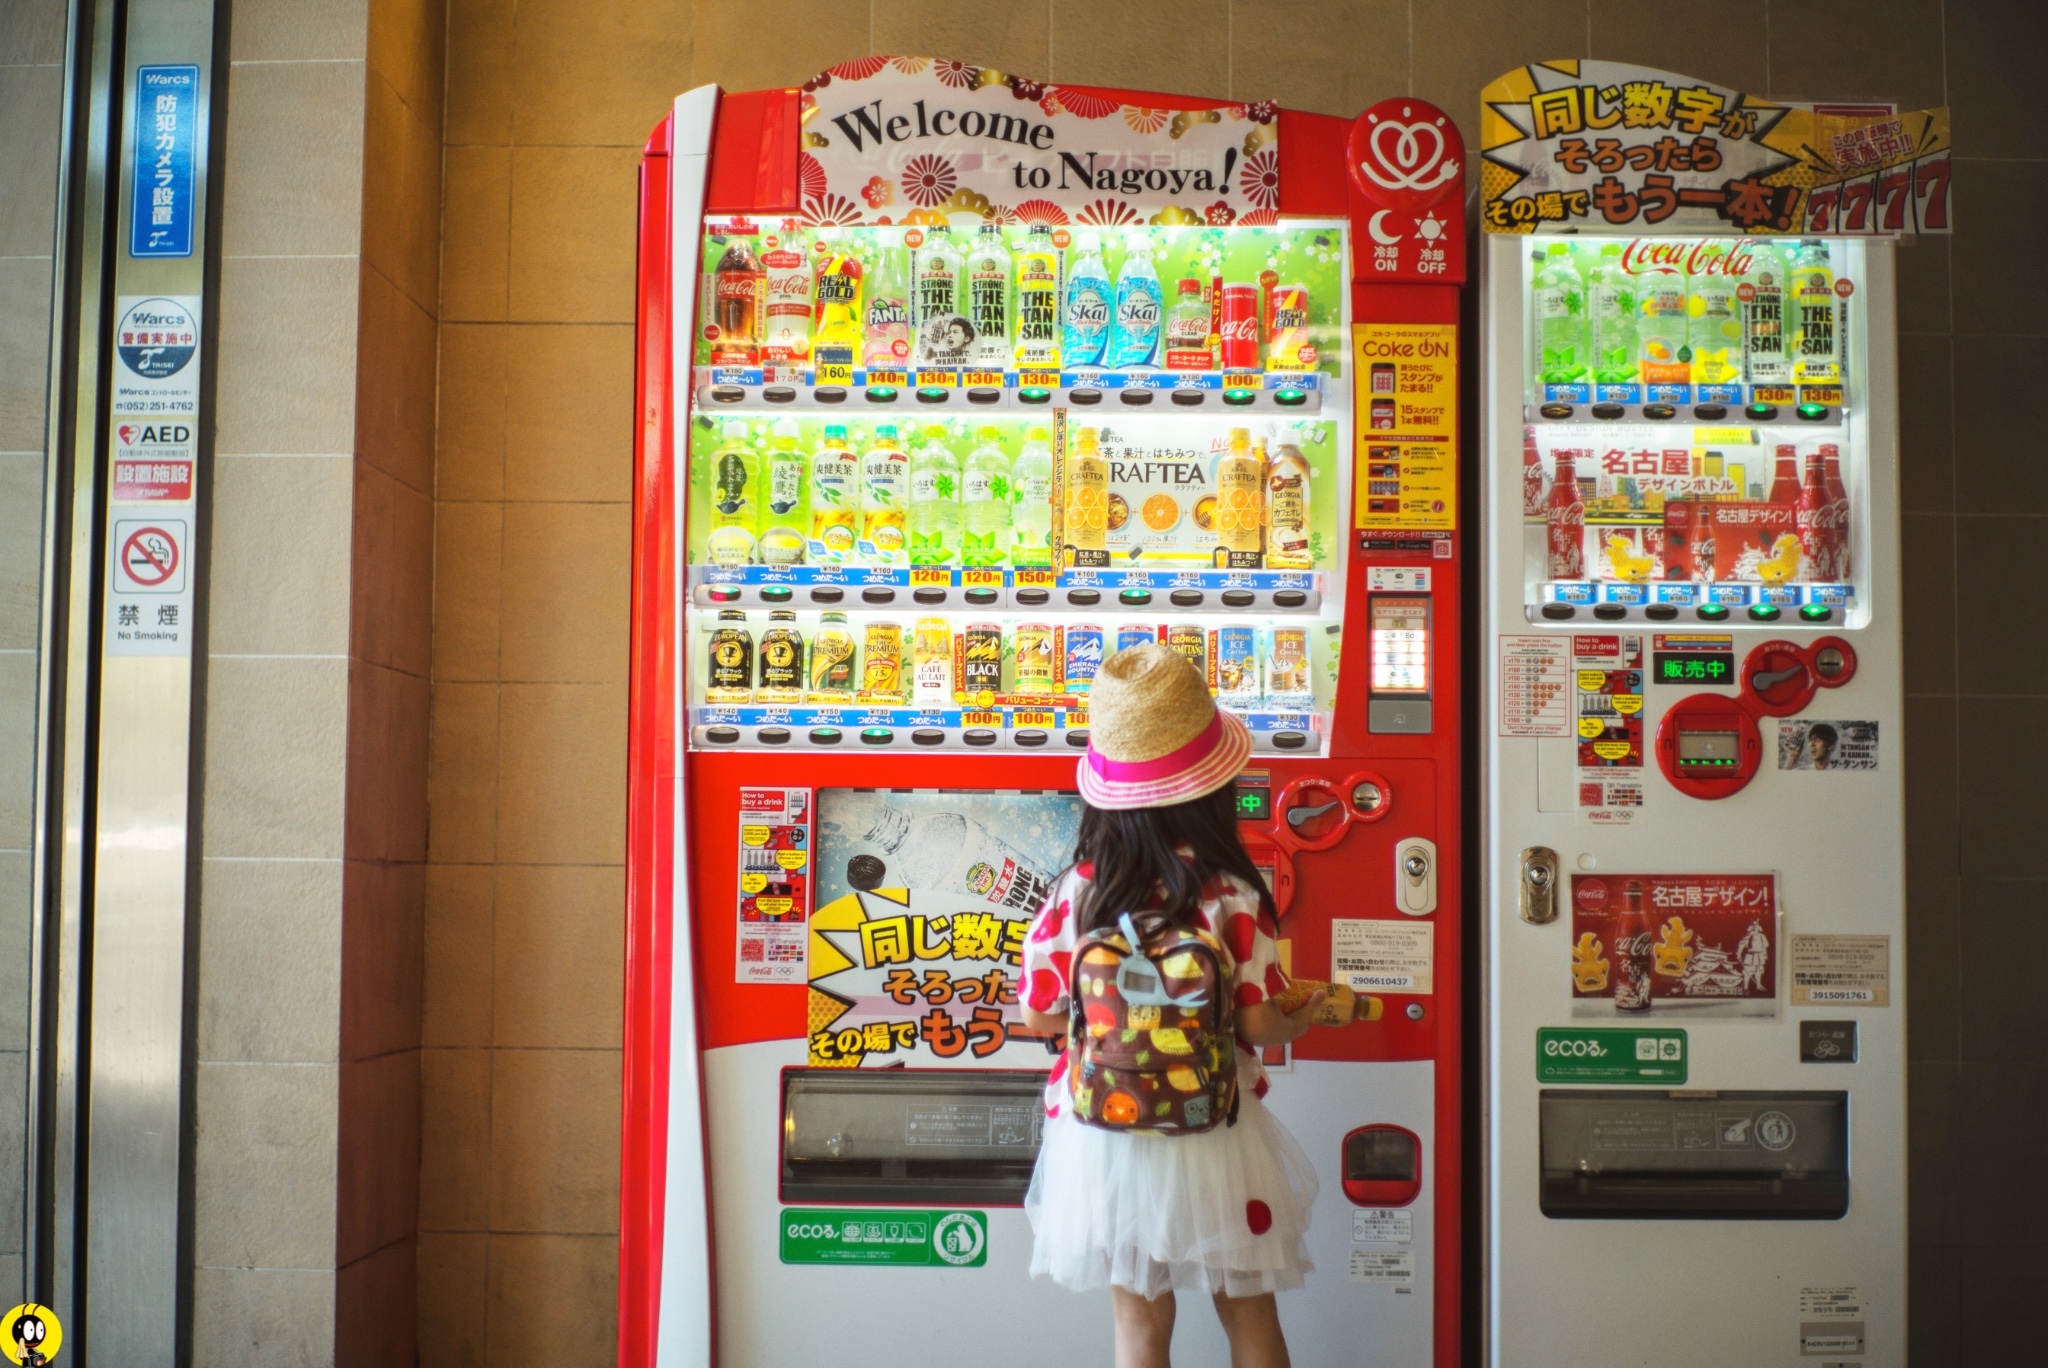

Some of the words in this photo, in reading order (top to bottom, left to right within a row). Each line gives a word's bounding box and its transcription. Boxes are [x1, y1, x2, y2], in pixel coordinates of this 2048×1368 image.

[146, 74, 190, 84] Warcs
[1529, 80, 1758, 141] 同じ数字が
[831, 99, 1055, 153] Welcome
[152, 95, 176, 224] 防犯カメラ設置
[1555, 138, 1723, 172] そろったら
[1014, 161, 1051, 190] to
[1059, 146, 1238, 194] Nagoya!
[1485, 190, 1588, 227] その場で
[1374, 246, 1398, 258] 冷却
[1420, 249, 1444, 261] 冷却
[1622, 238, 1753, 276] Coca-Cola
[1375, 260, 1397, 271] ON
[1418, 262, 1446, 274] OFF
[819, 275, 852, 286] REAL
[921, 280, 953, 289] STRONG
[973, 281, 1004, 290] STRONG
[818, 287, 854, 298] GOLD
[1837, 283, 1852, 292] NEW
[921, 290, 953, 304] THE
[973, 290, 1004, 305] THE
[1022, 292, 1053, 307] THE
[132, 313, 185, 324] Warcs
[869, 307, 906, 326] FANTA
[973, 306, 1004, 320] TAN
[1022, 308, 1053, 323] TAN
[1276, 308, 1303, 318] REAL
[1751, 306, 1781, 320] THE
[1801, 306, 1832, 321] THE
[1169, 318, 1208, 332] Coca-Cola
[1276, 318, 1304, 328] GOLD
[1022, 324, 1053, 340] SAN
[1801, 323, 1832, 338] TAN
[123, 332, 192, 344] 警備実施中
[1751, 336, 1782, 352] SAN
[1363, 341, 1414, 357] Coke
[1418, 339, 1448, 357] ON
[1801, 339, 1833, 354] SAN
[869, 373, 904, 382] 140円
[919, 373, 954, 384] 130円
[965, 373, 1001, 384] 130円
[1022, 374, 1057, 384] 130円
[1400, 373, 1443, 382] スタンプが
[1756, 390, 1792, 400] 130円
[1803, 390, 1840, 401] 130円
[1401, 405, 1444, 414] 15スタンプで
[141, 426, 190, 442] AED
[1602, 448, 1690, 475] 名古屋
[116, 464, 188, 484] 設置施設
[817, 463, 852, 475] 爽健美茶
[867, 463, 902, 475] 爽健美茶
[1638, 478, 1734, 492] デザインボトル
[1716, 509, 1792, 524] 名古屋デザイン!
[913, 571, 948, 582] 120円
[965, 572, 1000, 582] 120円
[118, 631, 131, 640] No
[134, 631, 178, 641] Smoking
[1172, 636, 1202, 644] GEORGIA
[813, 647, 849, 655] PREMIUM
[967, 665, 998, 676] BLACK
[1664, 660, 1725, 678] 販売中
[1005, 697, 1064, 705] バリューコーナー
[964, 713, 1000, 724] 100円
[1016, 713, 1052, 723] 100円
[1830, 760, 1877, 768] ザ・タンサン
[1589, 811, 1612, 819] Coca-Cola
[972, 865, 990, 892] CANADA
[981, 873, 990, 888] DRY
[1578, 890, 1605, 899] Coca-Cola
[1652, 886, 1768, 907] 名古屋デザイン!
[1353, 977, 1407, 985] 2906610437
[940, 1214, 978, 1229] のんだあとは
[943, 1253, 976, 1264] リサイクル
